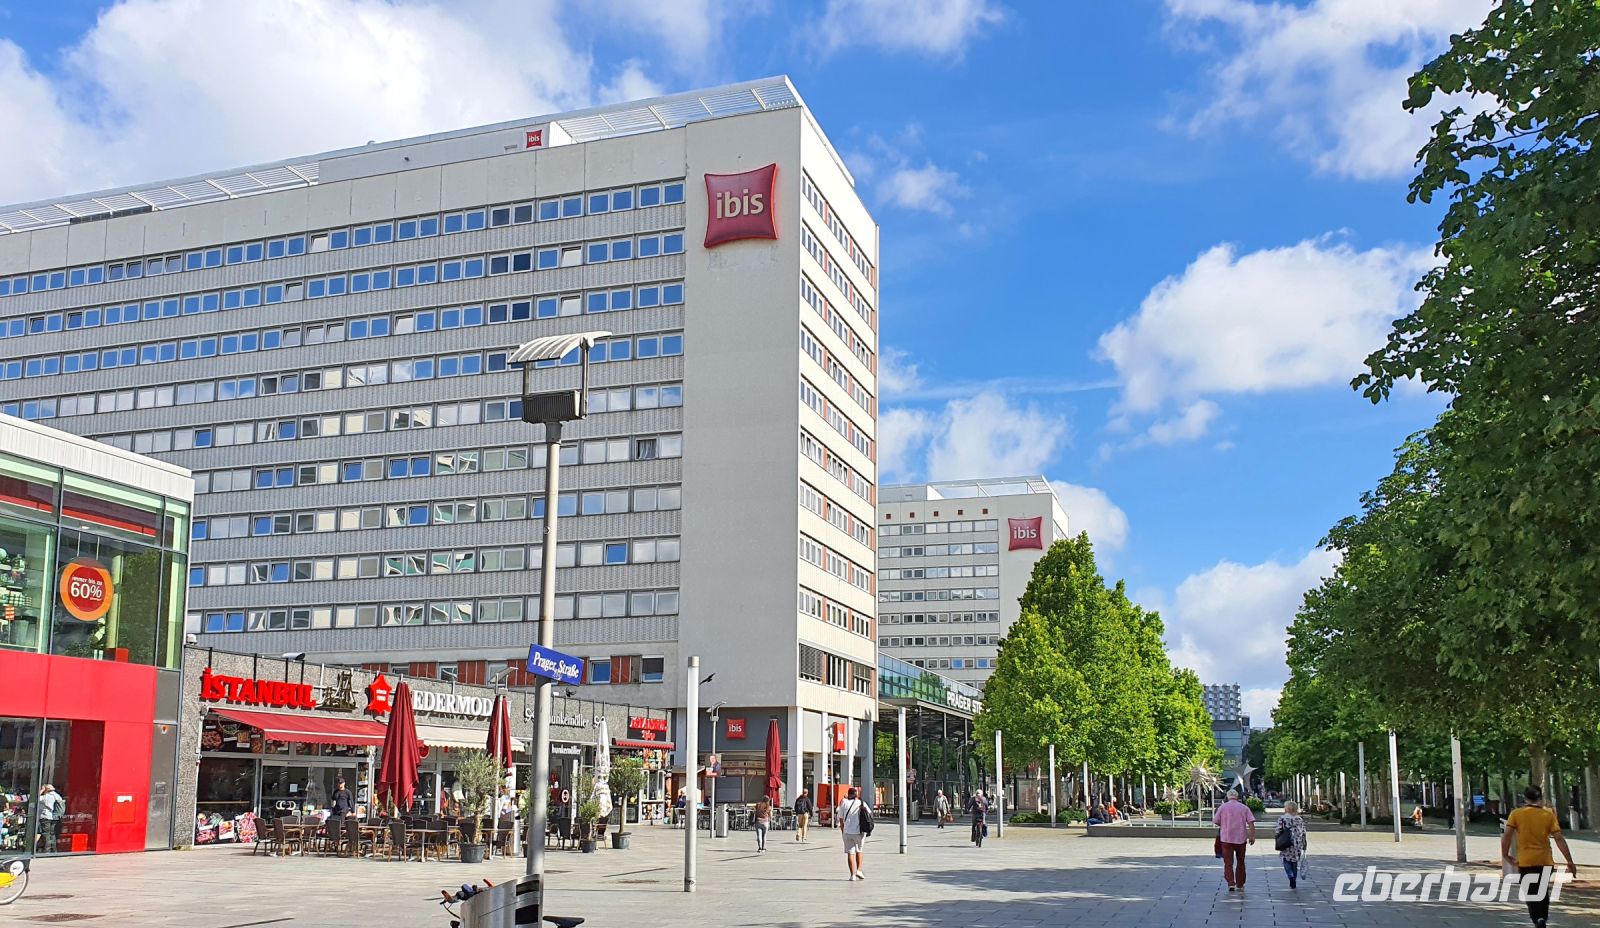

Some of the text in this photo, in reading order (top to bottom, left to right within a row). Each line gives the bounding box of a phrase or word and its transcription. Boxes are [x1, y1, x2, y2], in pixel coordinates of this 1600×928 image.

[528, 134, 541, 142] ibis
[716, 188, 764, 219] ibis
[1013, 526, 1037, 539] ibis
[70, 581, 103, 599] 60%
[532, 651, 557, 672] Prager
[558, 659, 580, 679] Straße
[412, 689, 511, 718] EDERMOD
[946, 690, 971, 712] PRAGER
[551, 711, 590, 728] unkemöller
[728, 723, 742, 733] ibis
